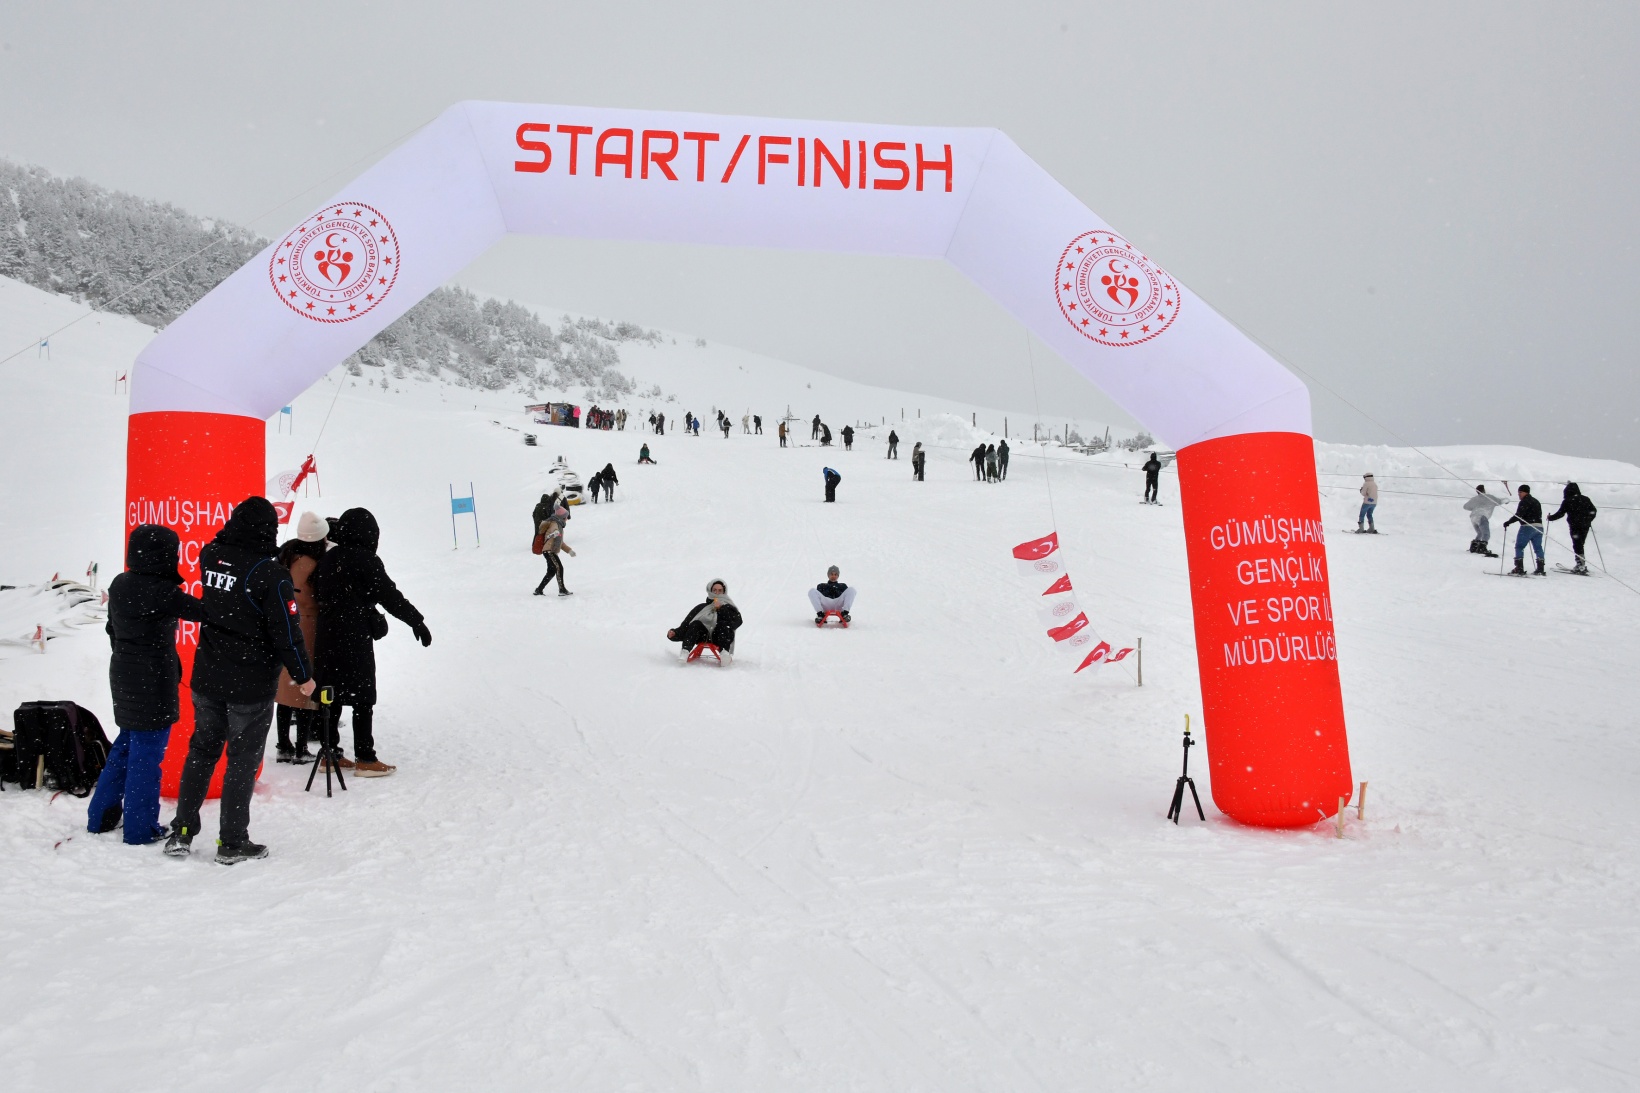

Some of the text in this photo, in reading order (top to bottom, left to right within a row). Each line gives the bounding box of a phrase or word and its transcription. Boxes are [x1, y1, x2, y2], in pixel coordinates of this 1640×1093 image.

[514, 122, 953, 193] START/FINISH
[325, 221, 359, 231] GENÇLİK
[359, 229, 369, 239] VE
[366, 238, 376, 261] SPOR
[293, 270, 321, 297] TÜRKİYE
[343, 263, 376, 298] BAKANLIĞI
[1137, 260, 1146, 268] VE
[1145, 268, 1158, 285] SPOR
[205, 570, 237, 592] TFF
[1237, 552, 1323, 588] GENÇLİK
[1227, 599, 1259, 626] VE
[1267, 596, 1321, 622] SPOR
